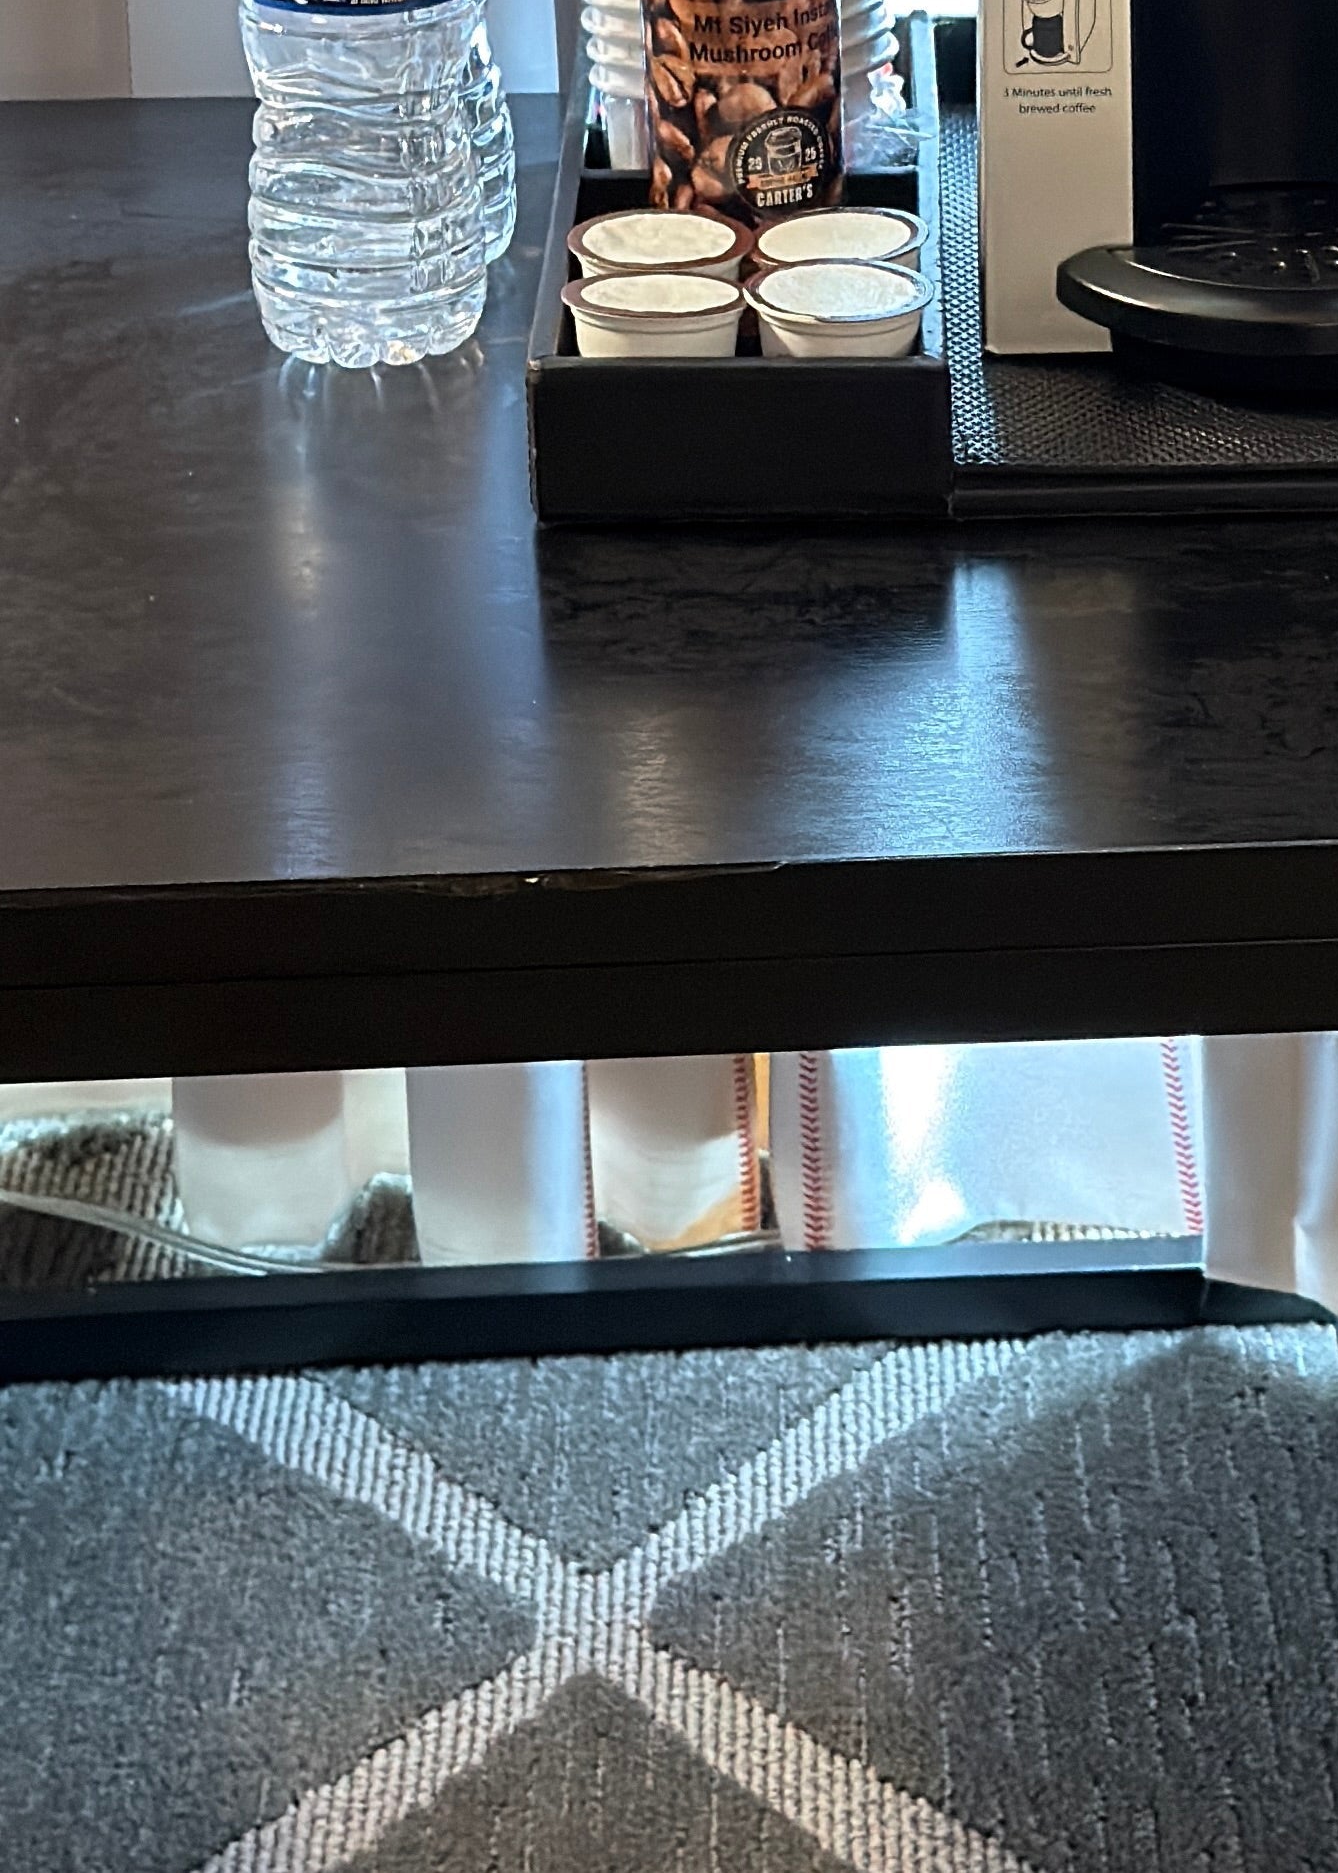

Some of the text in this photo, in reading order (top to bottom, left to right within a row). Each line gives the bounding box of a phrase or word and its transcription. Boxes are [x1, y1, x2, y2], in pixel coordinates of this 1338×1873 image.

[693, 13, 721, 34] Mt
[729, 11, 789, 38] Siyeh
[689, 40, 803, 63] Mushroom
[1012, 87, 1056, 98] Minutes
[1058, 86, 1083, 97] until
[1085, 86, 1112, 97] fresh
[1019, 103, 1097, 114] brewed coffee
[756, 183, 814, 207] CARTER'S
